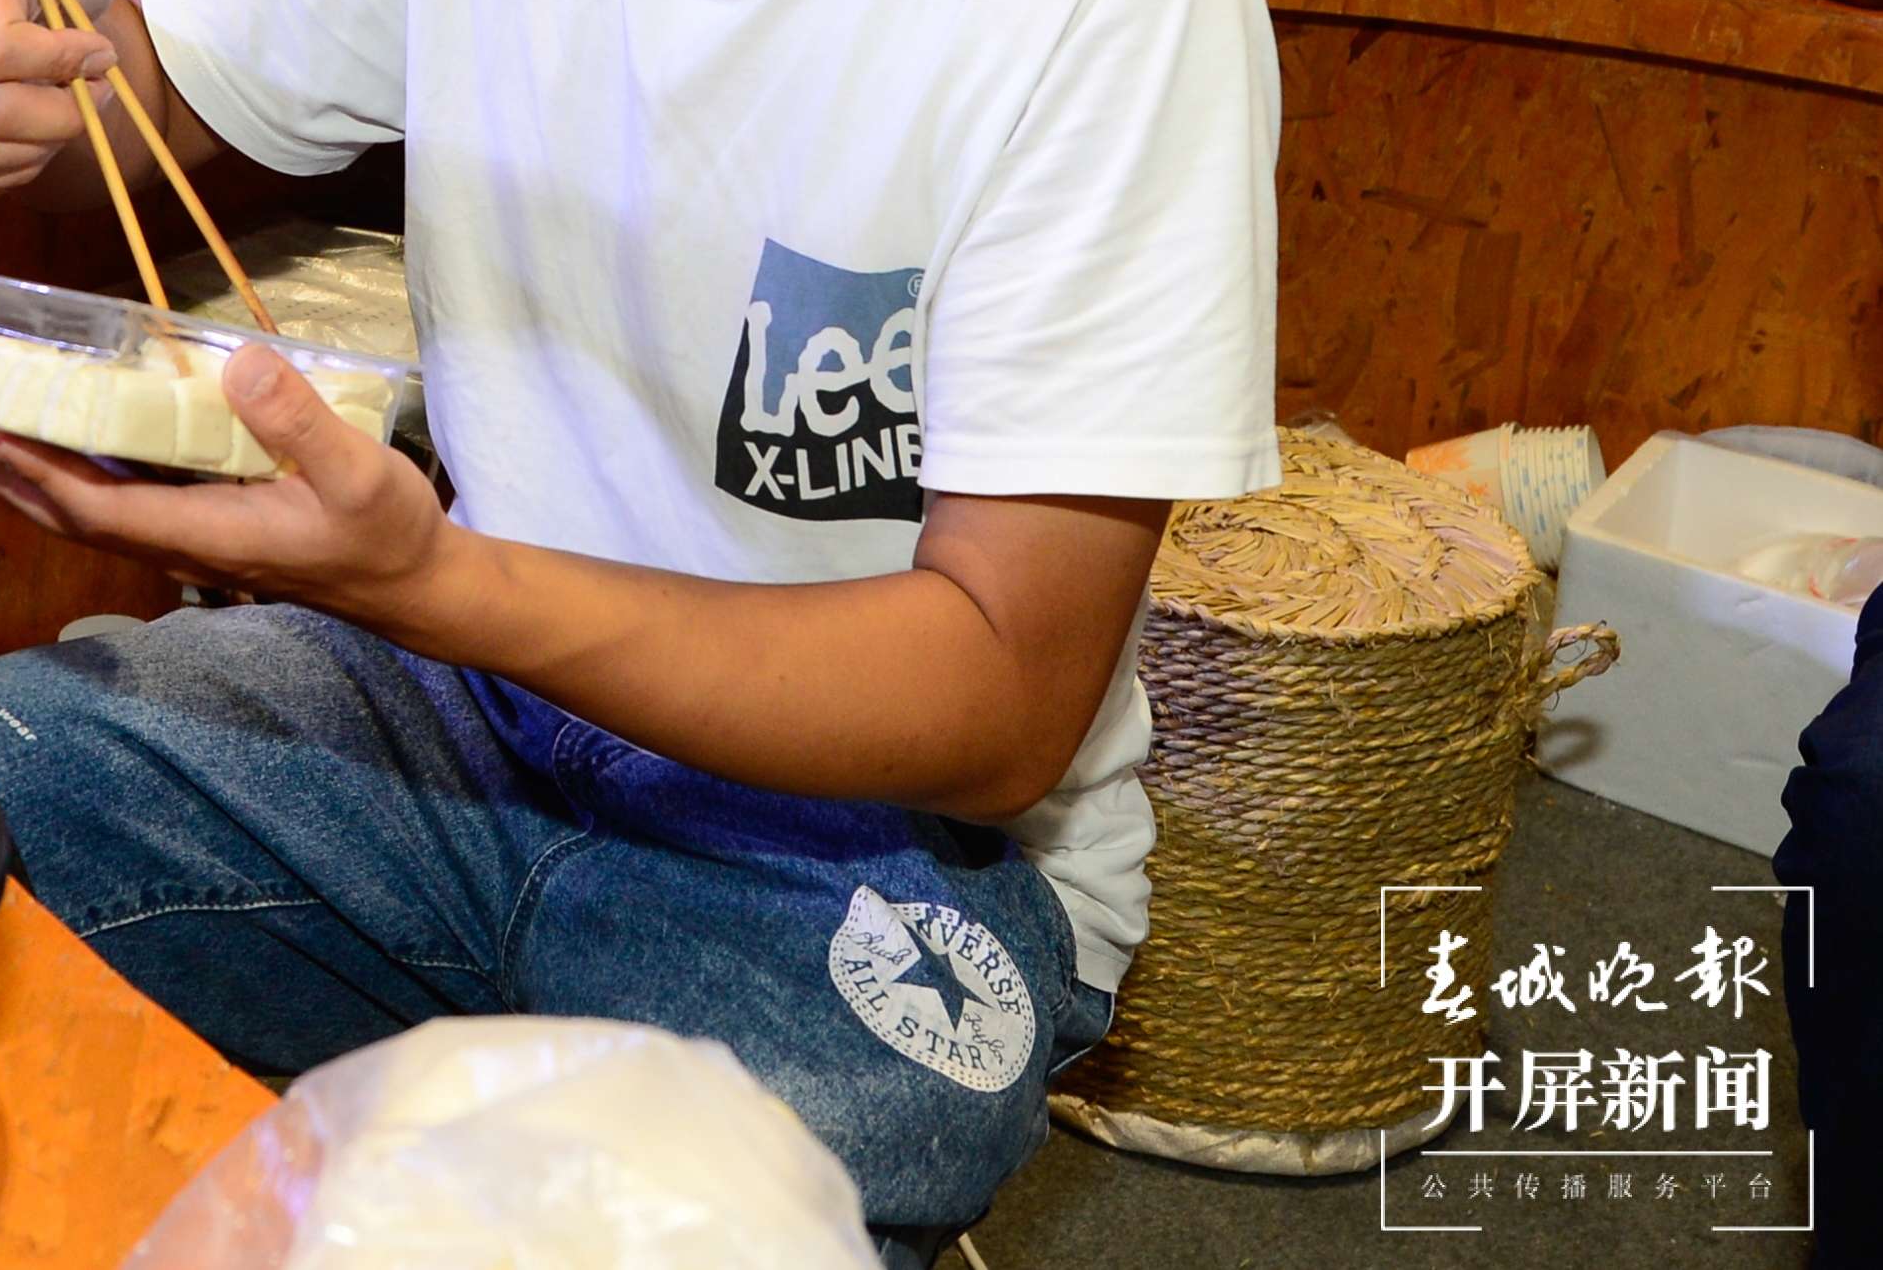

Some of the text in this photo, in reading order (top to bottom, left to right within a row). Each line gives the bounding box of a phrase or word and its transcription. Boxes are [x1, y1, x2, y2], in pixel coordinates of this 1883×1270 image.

[739, 300, 918, 438] Lee
[844, 958, 987, 1072] ALL STAR
